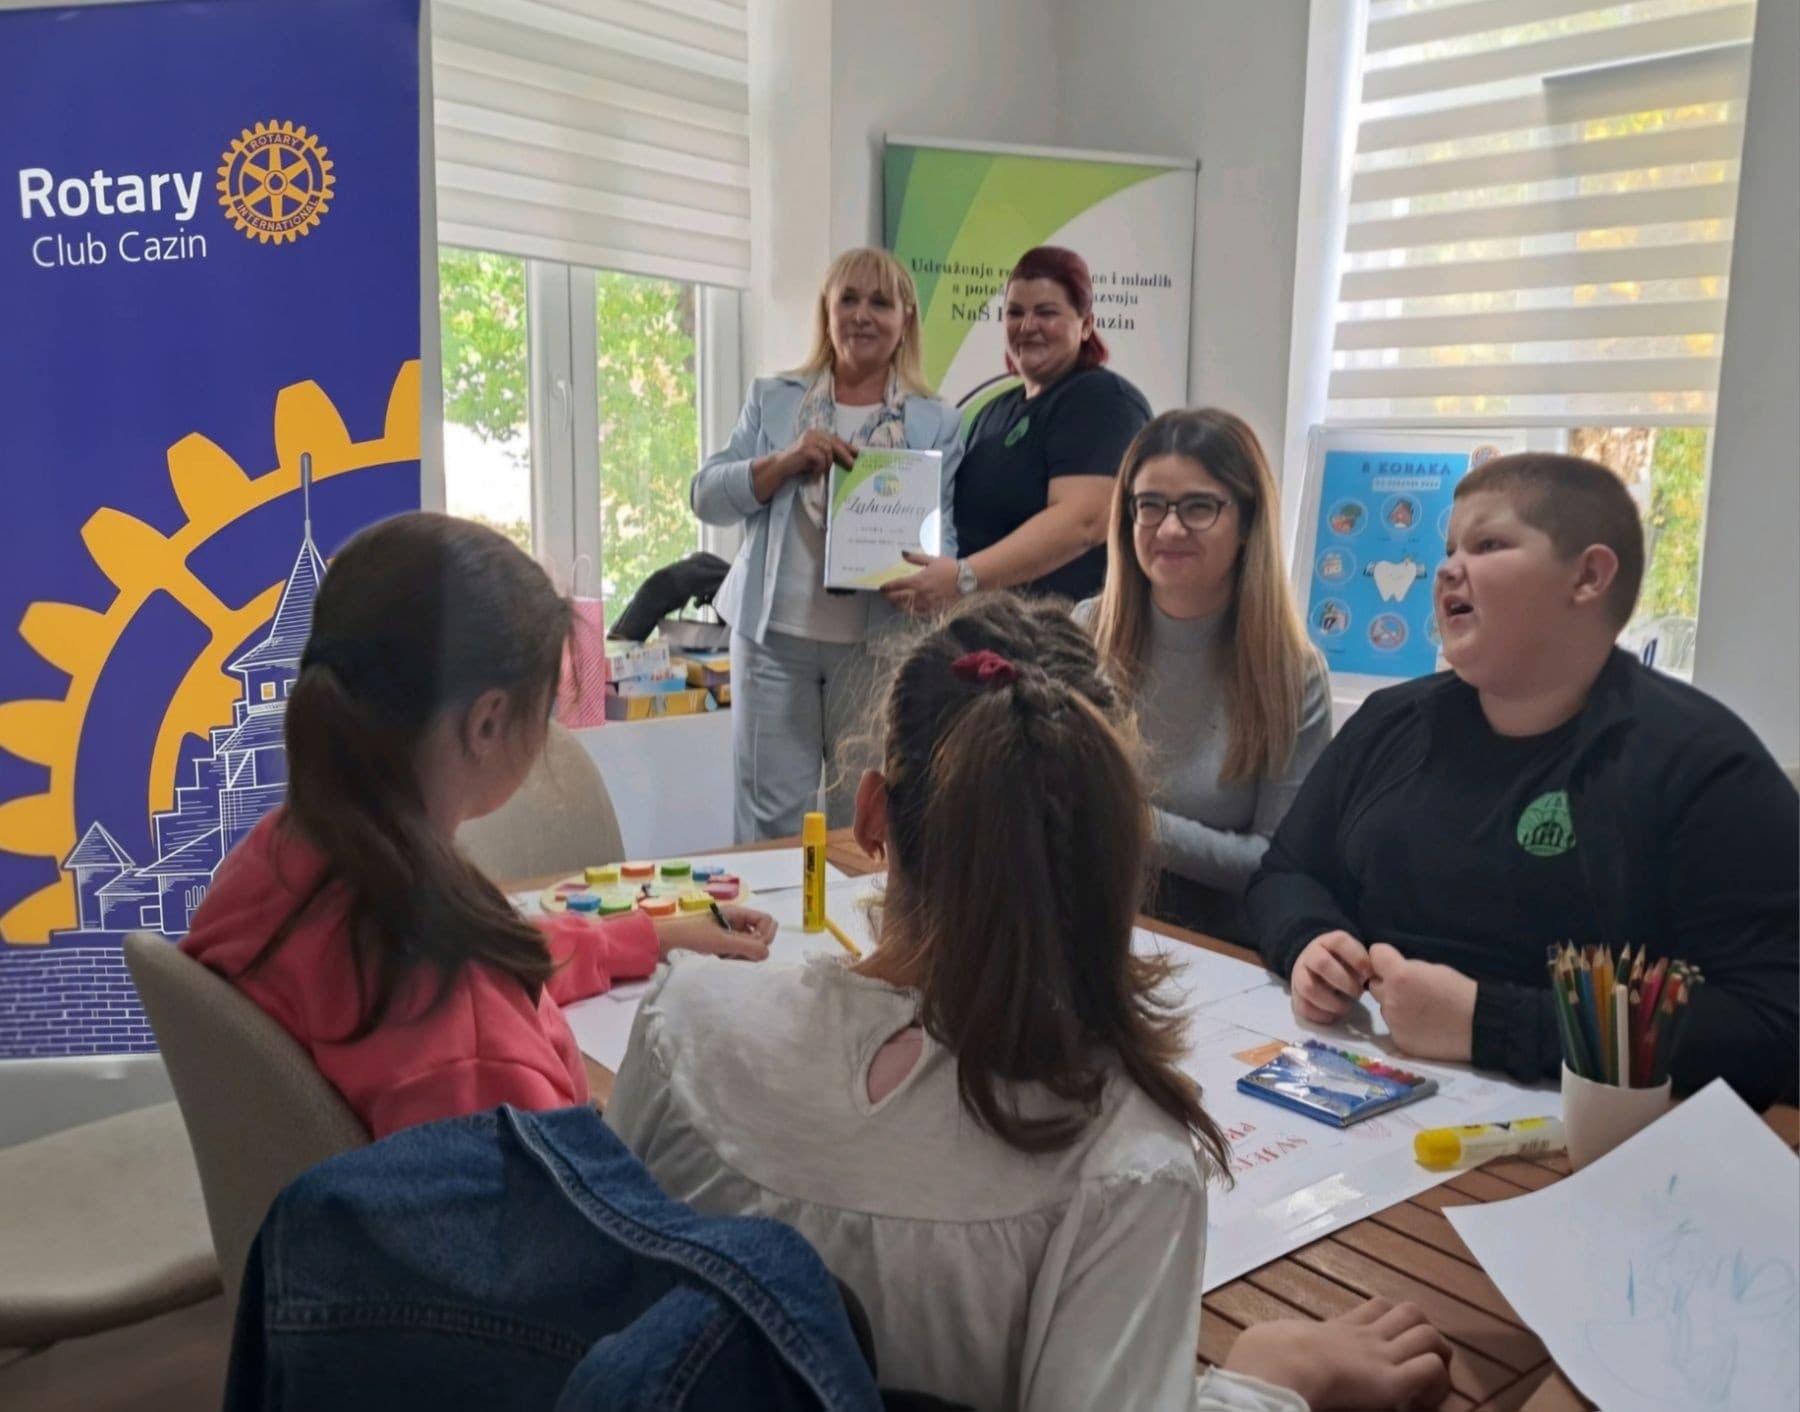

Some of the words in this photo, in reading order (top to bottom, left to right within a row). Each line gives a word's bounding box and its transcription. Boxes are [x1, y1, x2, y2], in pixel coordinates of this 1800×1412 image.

[250, 134, 299, 150] ROTARY
[19, 168, 203, 222] Rotary
[236, 200, 318, 231] INTERNATIONAL
[32, 232, 106, 268] Club
[118, 228, 207, 262] Cazin
[911, 257, 993, 279] Udruženje
[1121, 271, 1172, 289] mladih
[1096, 313, 1135, 331] azin
